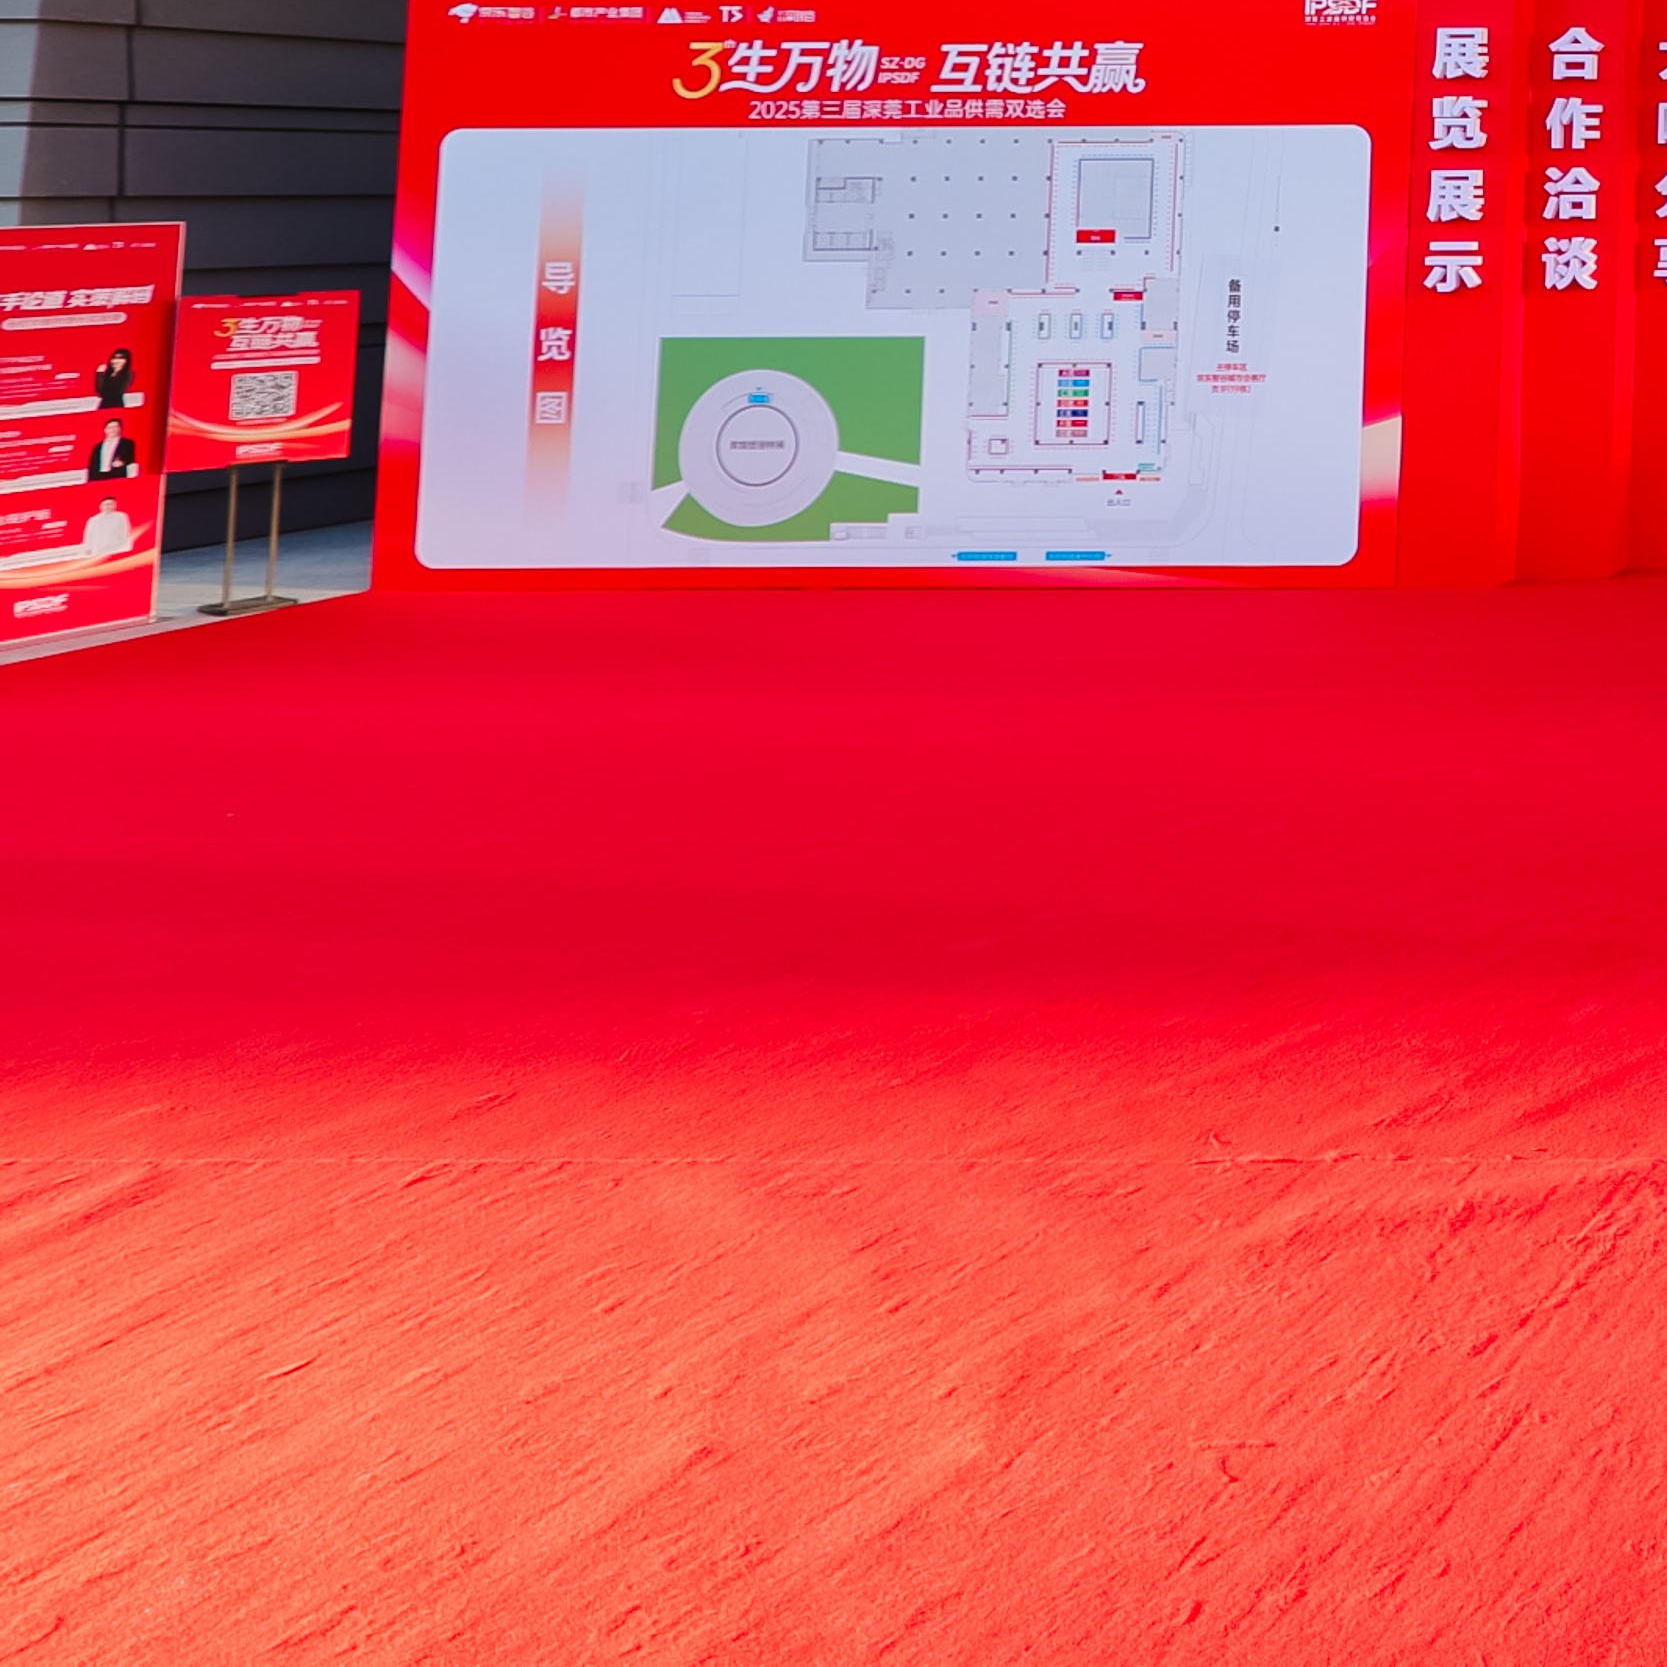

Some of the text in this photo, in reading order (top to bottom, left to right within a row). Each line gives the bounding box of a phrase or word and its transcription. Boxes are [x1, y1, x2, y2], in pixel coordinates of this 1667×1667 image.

[878, 71, 920, 84] IPSDF
[880, 56, 926, 69] SZ-DG
[930, 41, 1146, 94] 互链共赢
[749, 99, 1067, 120] 2025第三届深莞工业品供需双选会
[1422, 27, 1489, 293] 展览展示
[1542, 27, 1604, 291] 合作洽谈
[536, 261, 576, 425] 导览图
[1226, 279, 1241, 353] 备用停车场
